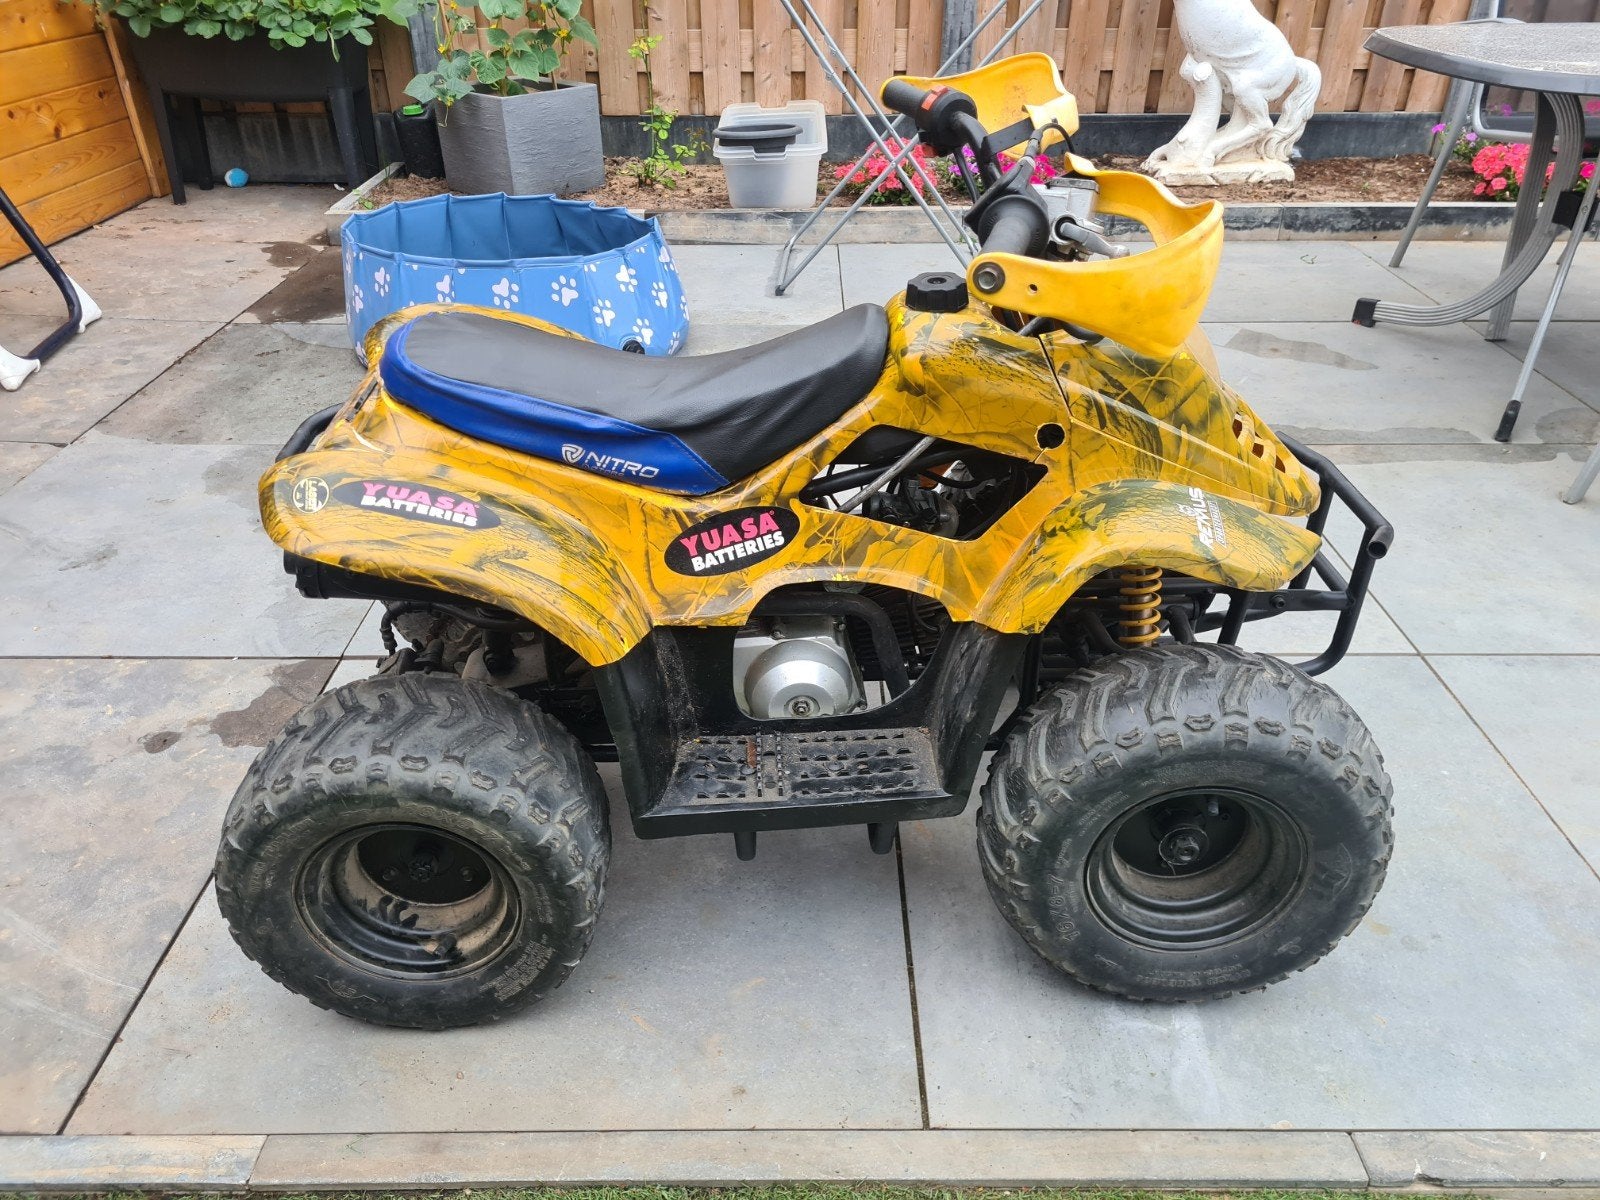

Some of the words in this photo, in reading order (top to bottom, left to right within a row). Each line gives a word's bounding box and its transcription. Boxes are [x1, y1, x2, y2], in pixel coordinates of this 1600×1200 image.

[584, 451, 660, 478] NITRO
[360, 495, 478, 527] BATTERIES
[362, 481, 477, 518] YUASA
[1182, 487, 1215, 550] REMUS
[680, 511, 780, 557] YUASA
[691, 530, 785, 572] BATTERIES
